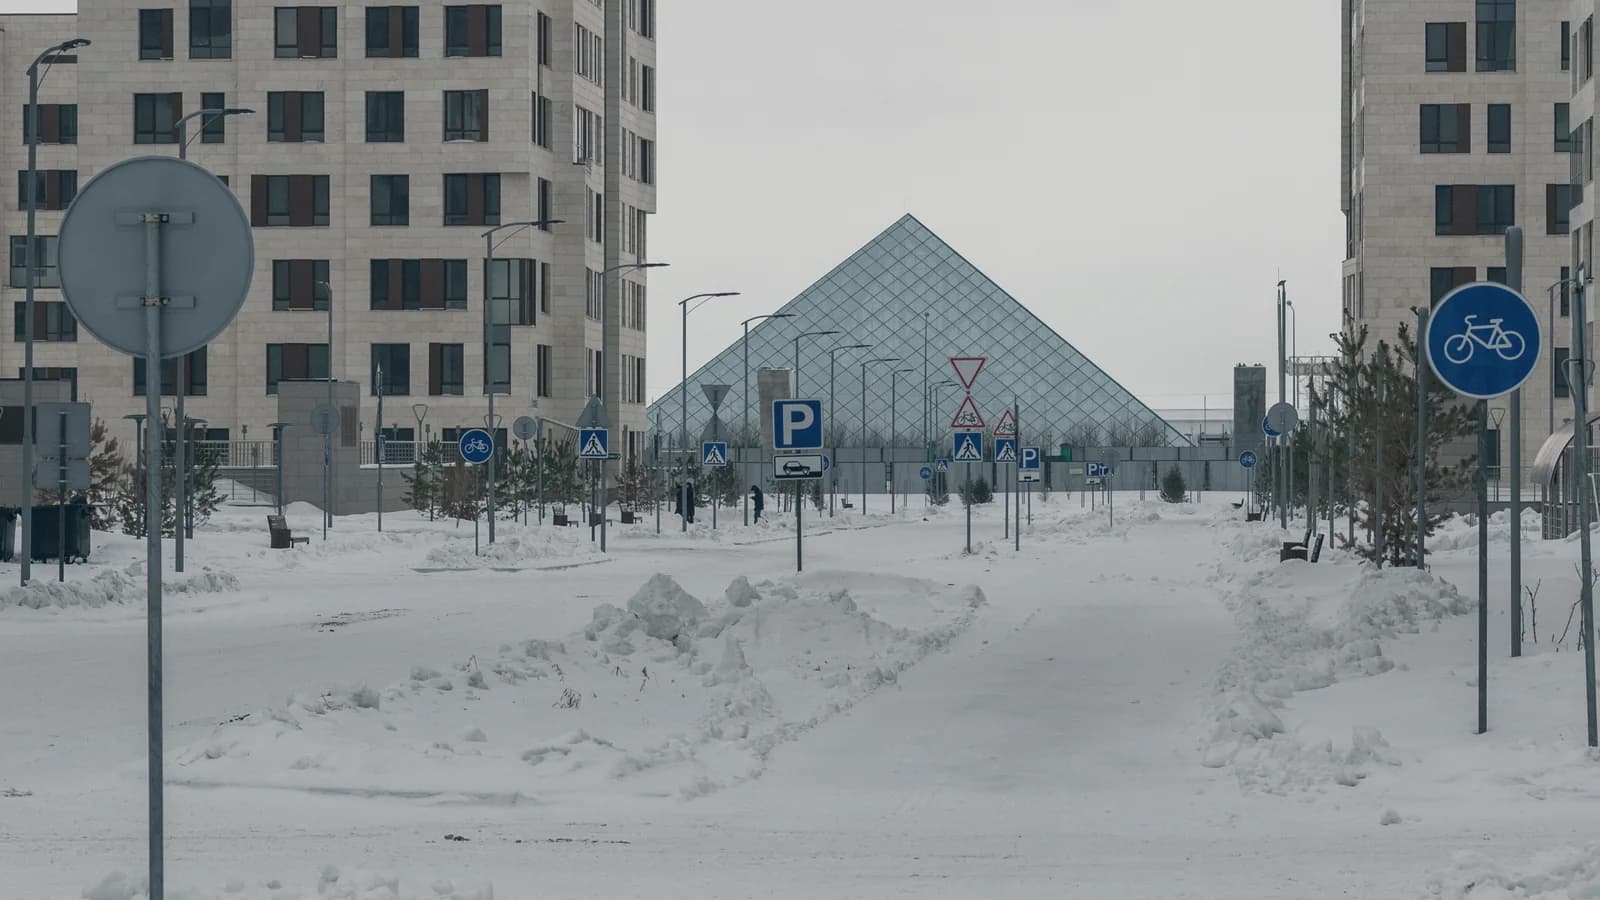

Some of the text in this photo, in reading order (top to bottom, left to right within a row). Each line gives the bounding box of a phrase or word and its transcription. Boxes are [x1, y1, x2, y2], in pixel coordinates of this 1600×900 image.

[783, 404, 814, 445] P
[1022, 448, 1037, 468] P
[1088, 463, 1098, 476] P
